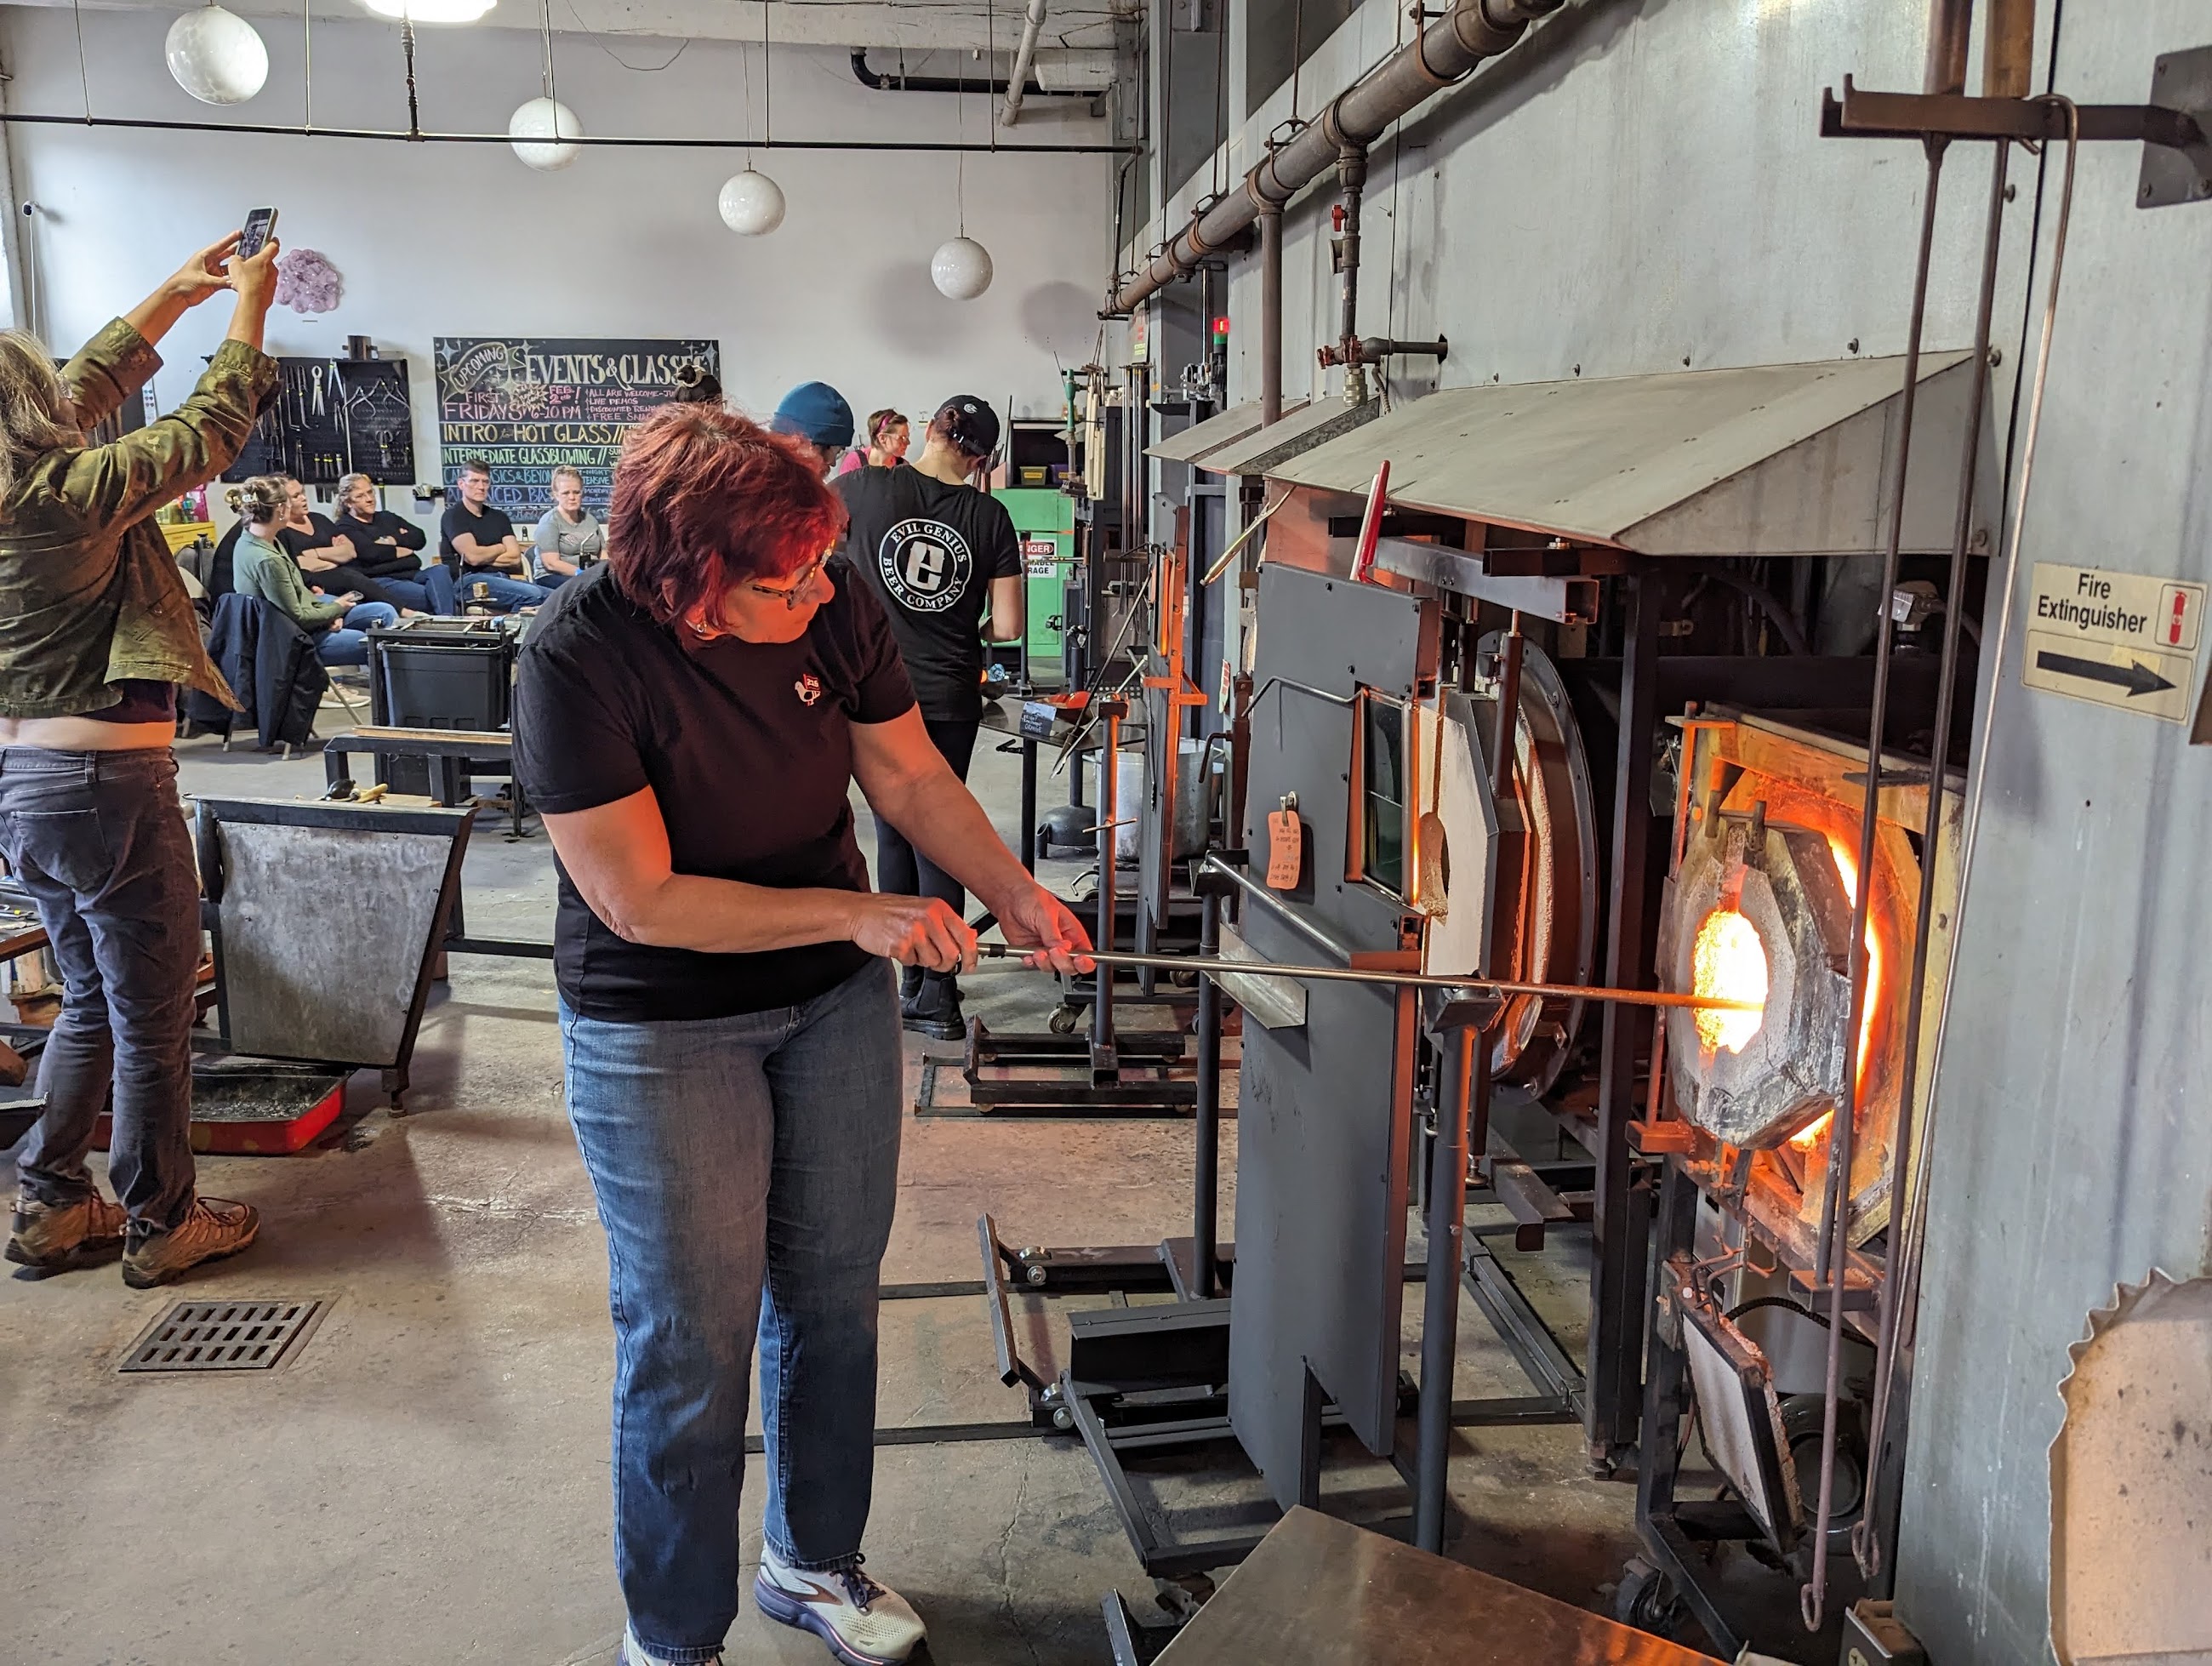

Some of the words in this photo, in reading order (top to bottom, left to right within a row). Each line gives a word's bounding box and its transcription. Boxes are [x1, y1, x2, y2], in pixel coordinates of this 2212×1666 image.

[453, 345, 504, 388] UPCOMING
[465, 391, 500, 403] FIRST
[589, 389, 605, 397] ALL
[606, 389, 623, 397] ARE
[444, 402, 524, 421] FRIDAYS
[562, 405, 582, 419] PM
[593, 413, 622, 421] FREE
[626, 413, 653, 421] SNAC
[443, 424, 498, 442] INTRO
[513, 424, 550, 442] HOT
[554, 424, 612, 444] GLASS
[518, 448, 596, 465] GLASSBLOWING
[524, 469, 551, 483] BEYON
[527, 487, 554, 502] BAS
[890, 522, 921, 544] EVIL
[923, 524, 967, 563] GENIUS
[883, 557, 905, 596] BEER
[906, 577, 963, 609] COMPANY
[2077, 573, 2111, 599] Fire
[2037, 595, 2147, 634] Extinguisher
